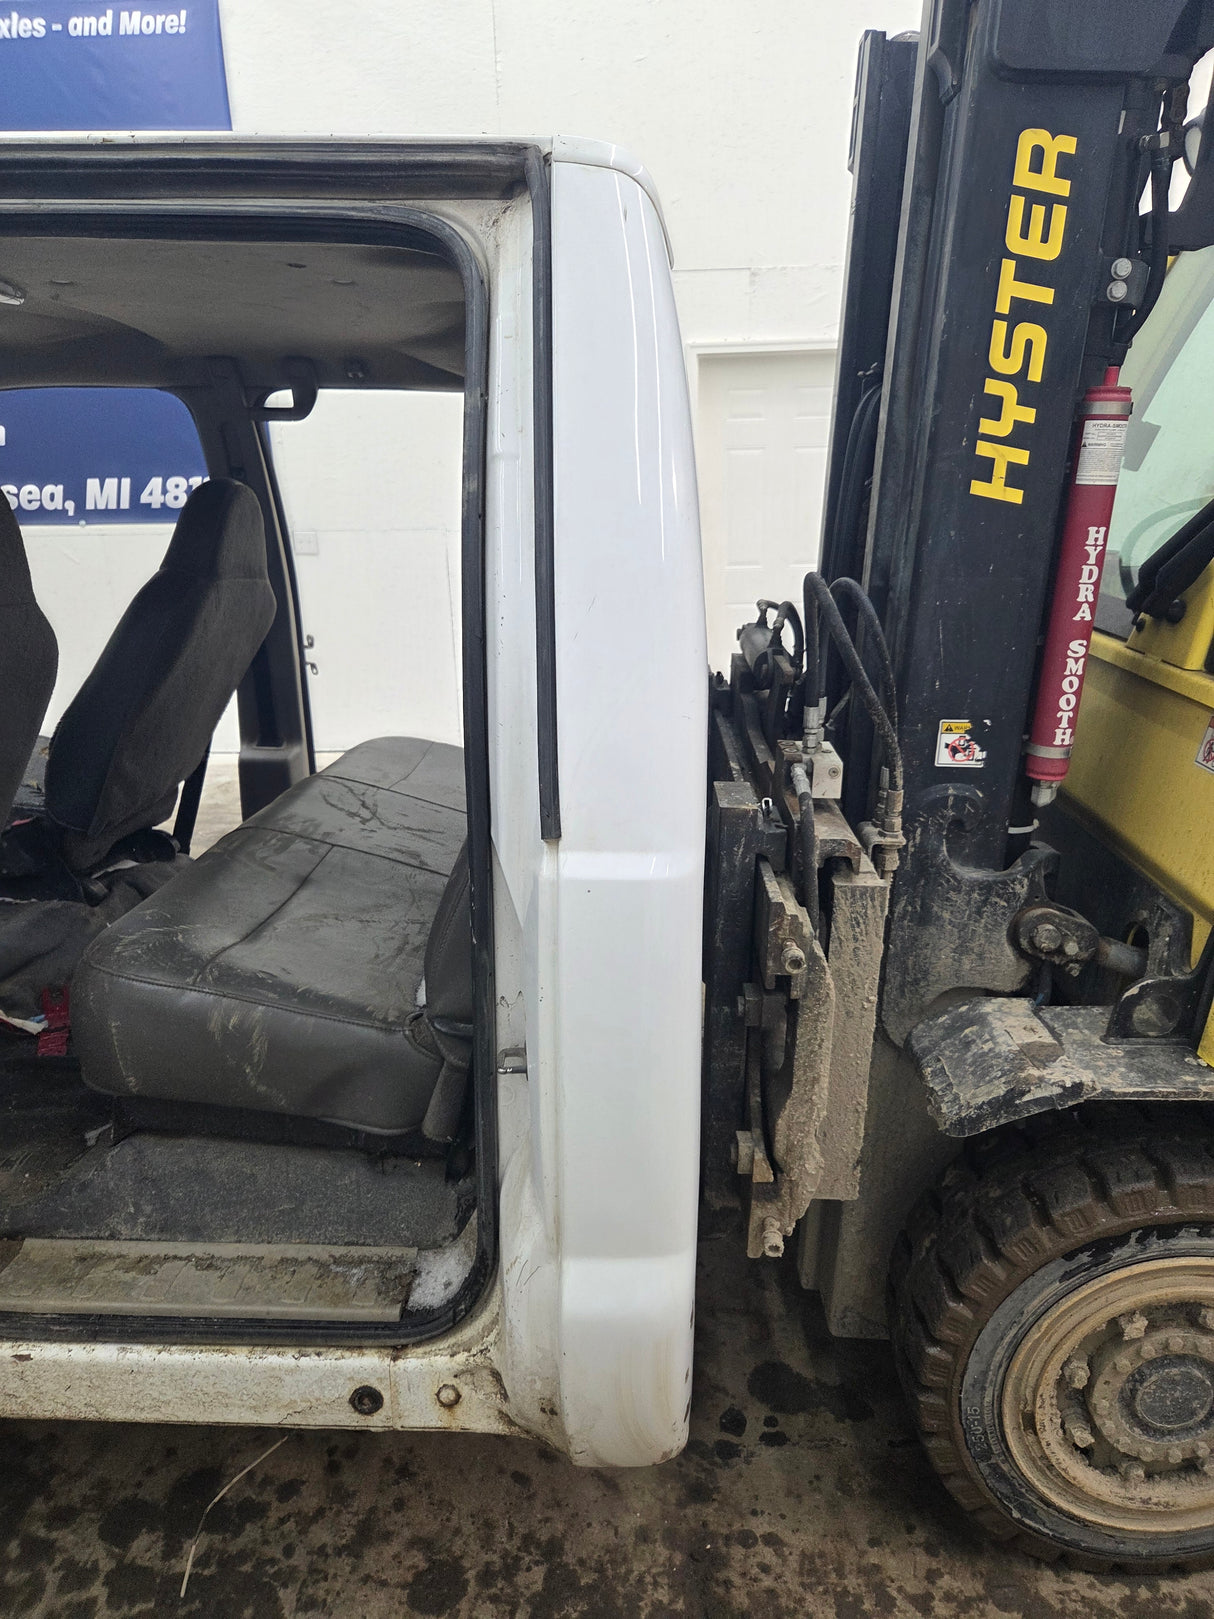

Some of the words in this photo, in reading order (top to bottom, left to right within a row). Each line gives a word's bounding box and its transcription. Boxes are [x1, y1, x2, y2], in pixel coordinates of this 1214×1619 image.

[68, 9, 113, 37] and
[119, 9, 187, 36] More!
[969, 127, 1077, 504] HYSTER
[1, 483, 75, 516] sea,
[85, 477, 131, 510] MI
[1073, 526, 1107, 621] HYDRA
[1053, 639, 1087, 745] SMOOTH
